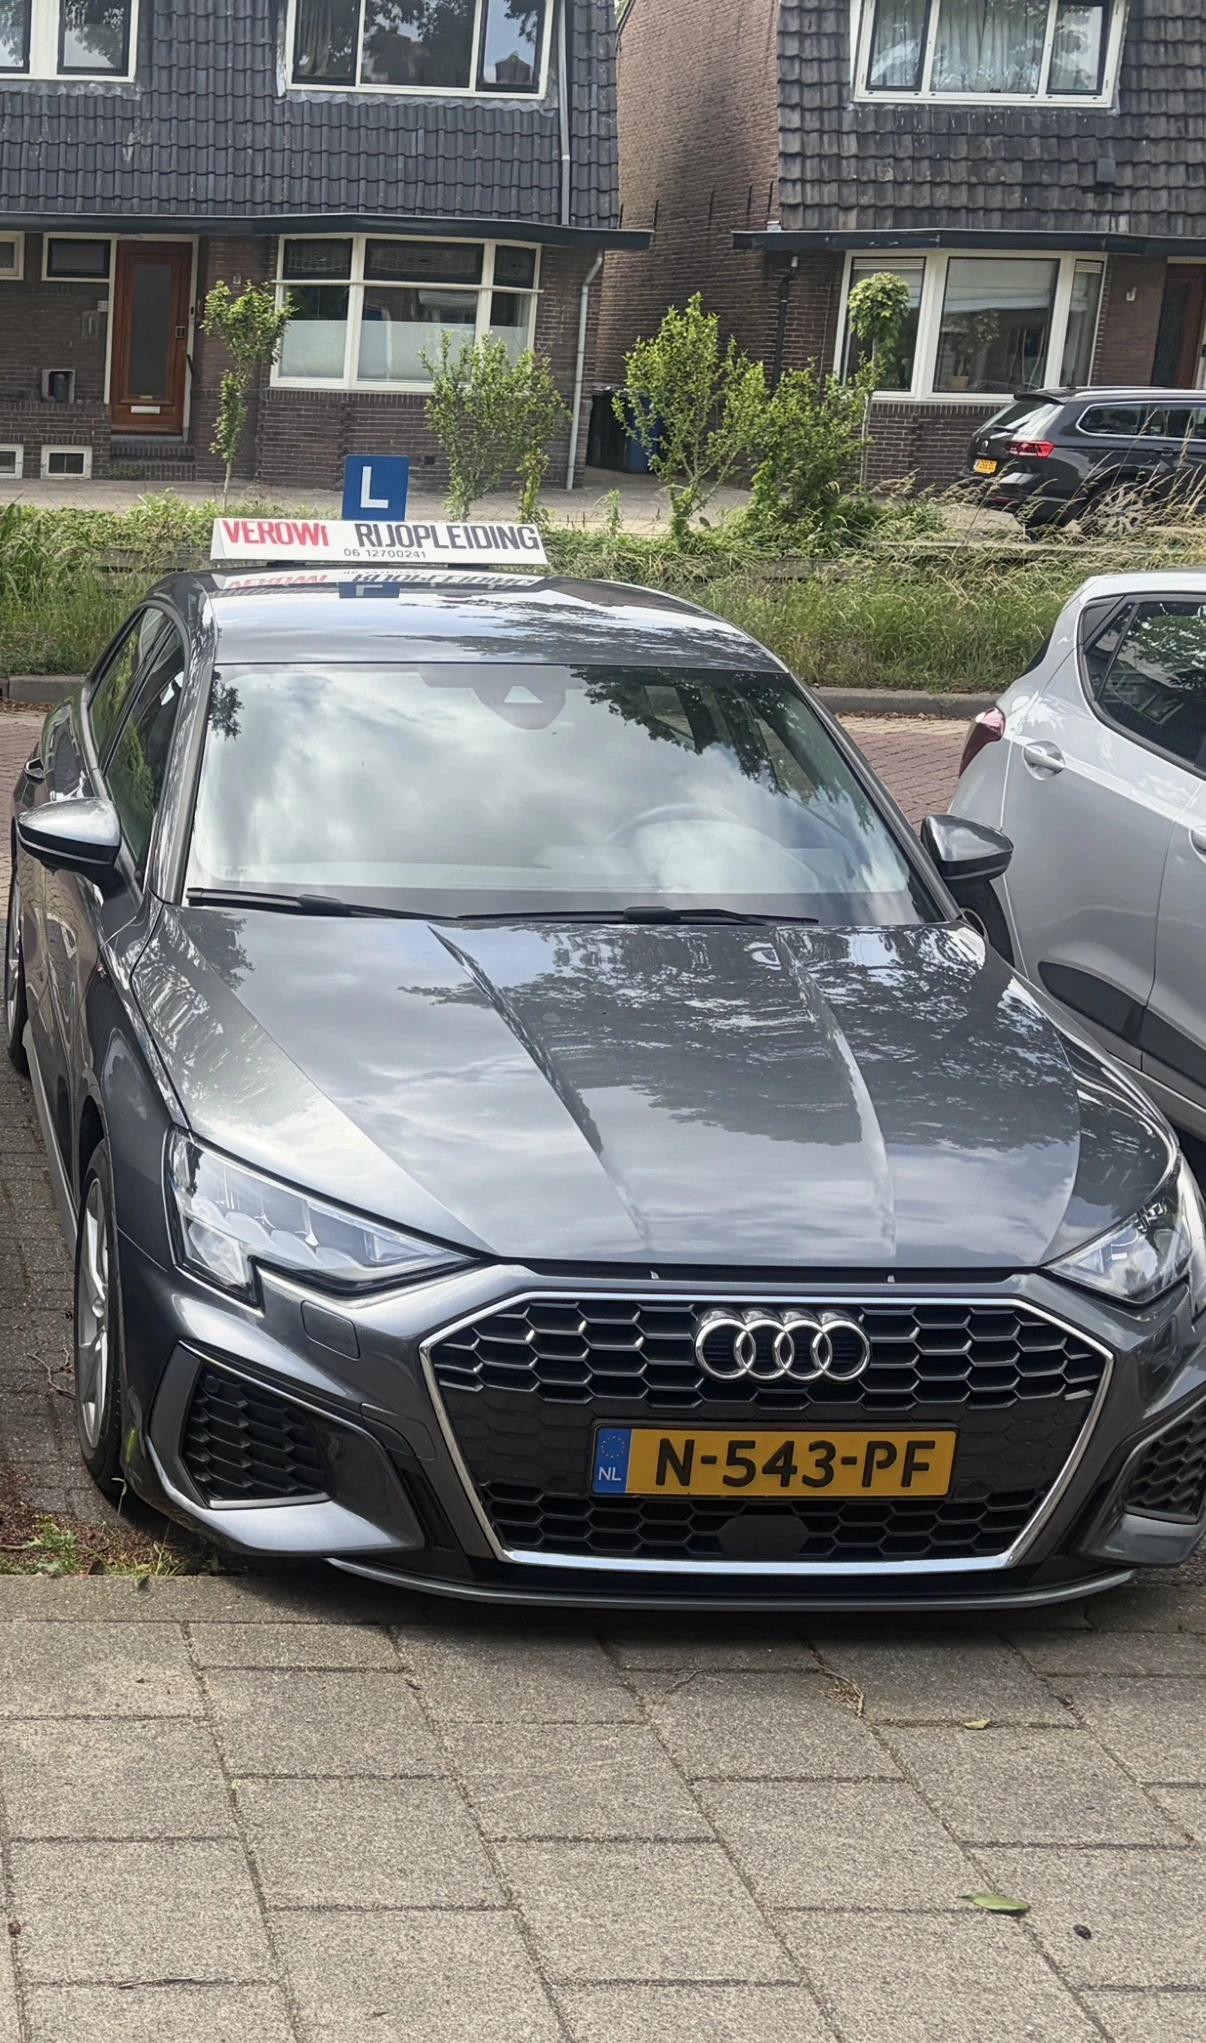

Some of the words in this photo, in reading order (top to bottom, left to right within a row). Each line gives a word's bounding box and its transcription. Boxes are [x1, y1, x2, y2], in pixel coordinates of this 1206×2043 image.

[360, 465, 389, 509] L
[222, 519, 330, 547] VEROWI
[354, 523, 541, 551] RIJOPLEIDING
[343, 548, 361, 557] 06
[365, 549, 426, 559] 12700241
[598, 1466, 622, 1482] NL
[655, 1437, 936, 1489] N-543-PF
